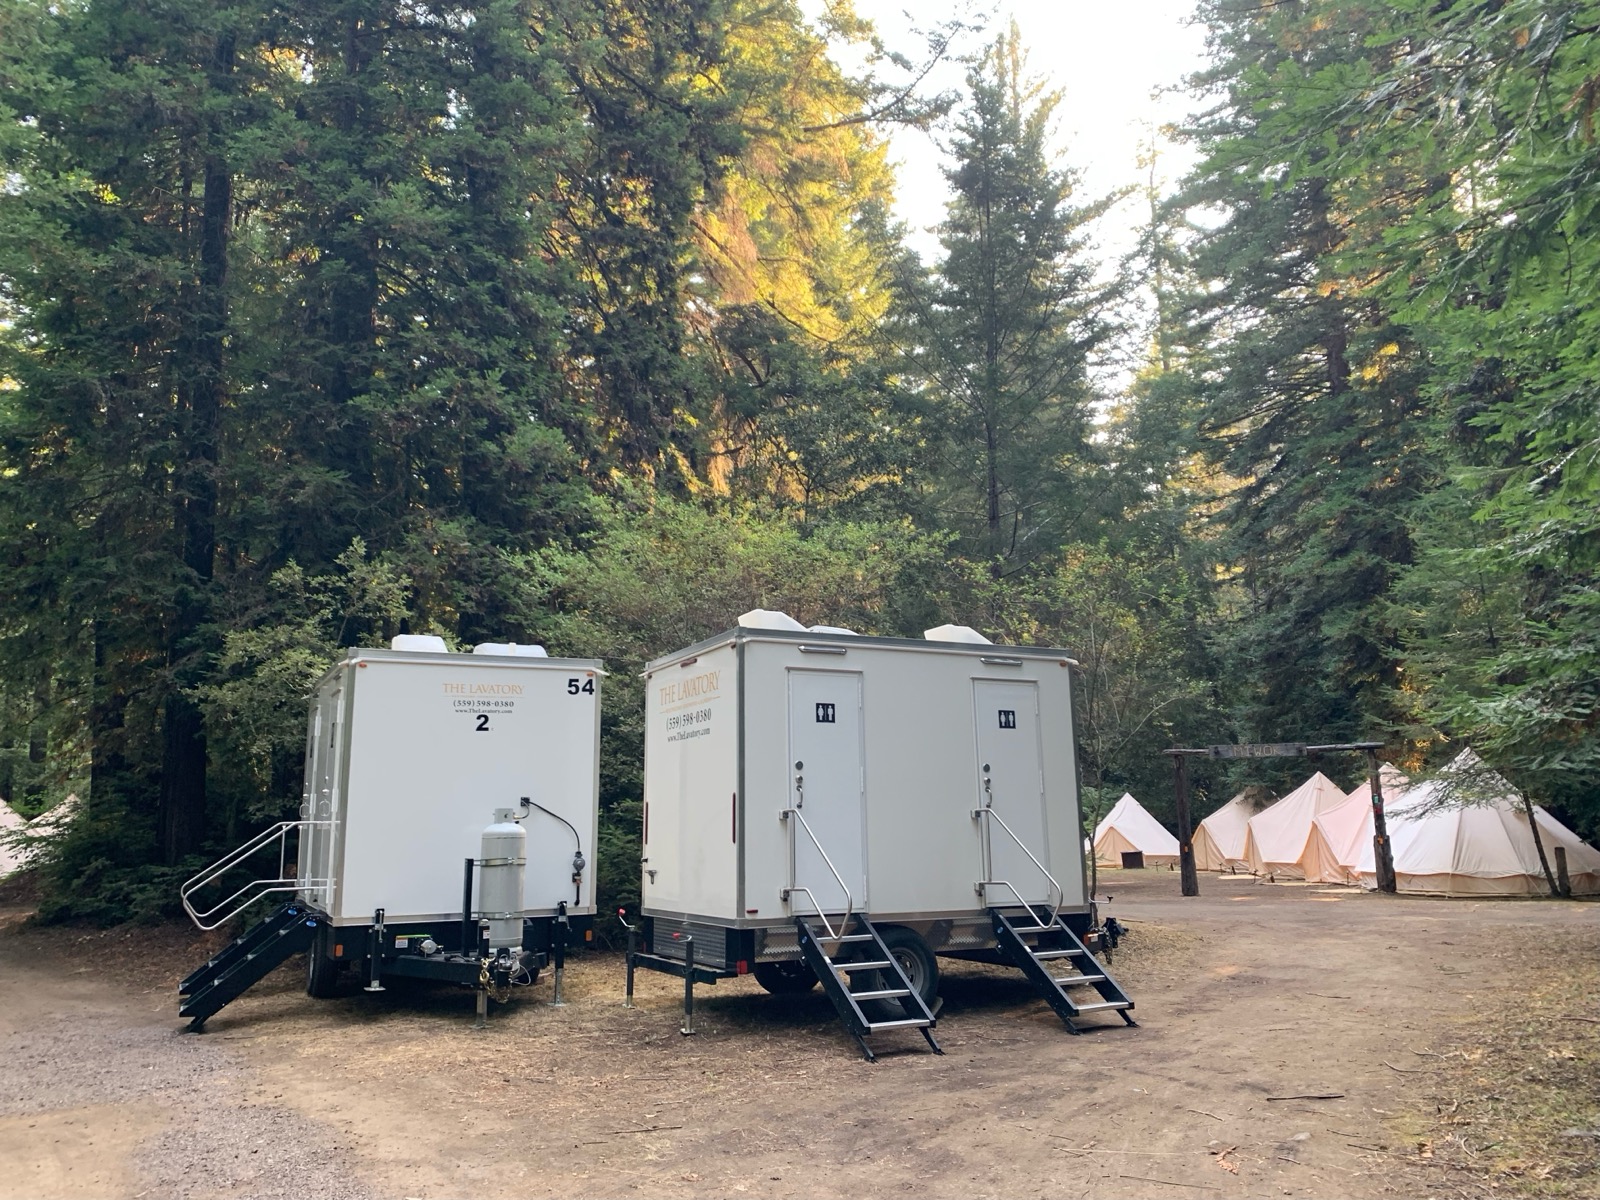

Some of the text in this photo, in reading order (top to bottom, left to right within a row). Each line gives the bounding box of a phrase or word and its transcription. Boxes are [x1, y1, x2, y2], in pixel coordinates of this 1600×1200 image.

[442, 683, 525, 695] THE LAVATORY
[567, 678, 595, 695] 54
[659, 684, 676, 706] THE
[677, 670, 721, 701] LAVATORY
[453, 699, 515, 708] (559) 598-0380
[475, 714, 490, 731] 2
[666, 707, 712, 732] (559) 598-0380
[667, 728, 711, 742] www.TheLavatory.com
